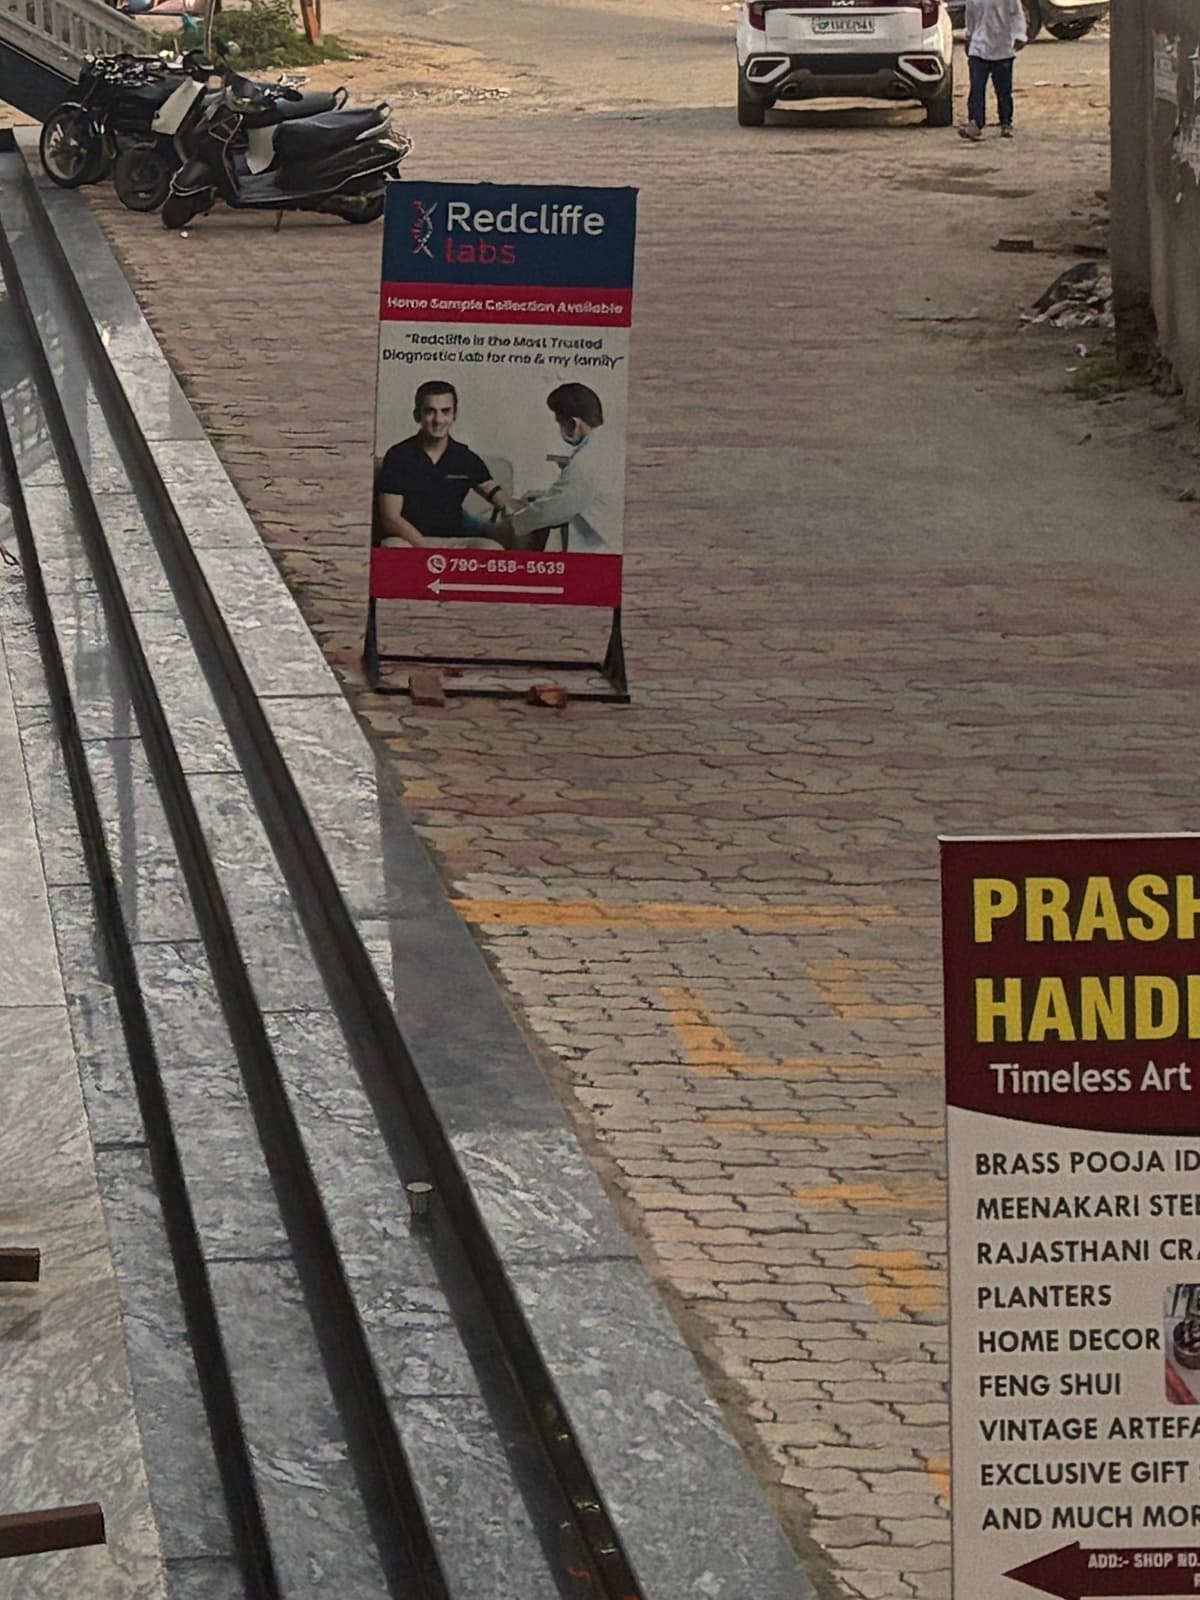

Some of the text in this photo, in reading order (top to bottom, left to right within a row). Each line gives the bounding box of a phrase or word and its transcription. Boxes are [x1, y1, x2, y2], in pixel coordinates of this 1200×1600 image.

[446, 201, 605, 236] Redcliffe
[387, 296, 624, 314] Home Sample Collection Available
[473, 334, 485, 346] is
[487, 334, 511, 347] the
[513, 335, 547, 348] Most
[551, 336, 603, 350] Trusted
[382, 348, 456, 364] Diagnostic
[458, 351, 484, 363] Lab
[486, 351, 506, 363] for
[508, 355, 532, 364] me
[534, 354, 545, 365] &
[548, 356, 570, 368] my
[989, 1060, 1192, 1094] Timeless Art
[975, 1152, 1060, 1175] BRASS
[1070, 1150, 1165, 1174] POOJA
[976, 1194, 1139, 1220] MEENAKARI
[977, 1238, 1200, 1265] RAJASTHANI CR
[977, 1284, 1112, 1309] PLANTERS
[978, 1328, 1161, 1353] HOME DECOR
[979, 1373, 1121, 1397] FENG SHUI
[979, 1417, 1098, 1441] VINTAGE
[980, 1461, 1122, 1486] EXCLUSIVE
[1130, 1460, 1190, 1484] GIFT
[982, 1507, 1042, 1531] AND
[1051, 1505, 1133, 1529] MUCH
[1133, 1552, 1173, 1568] SHOP
